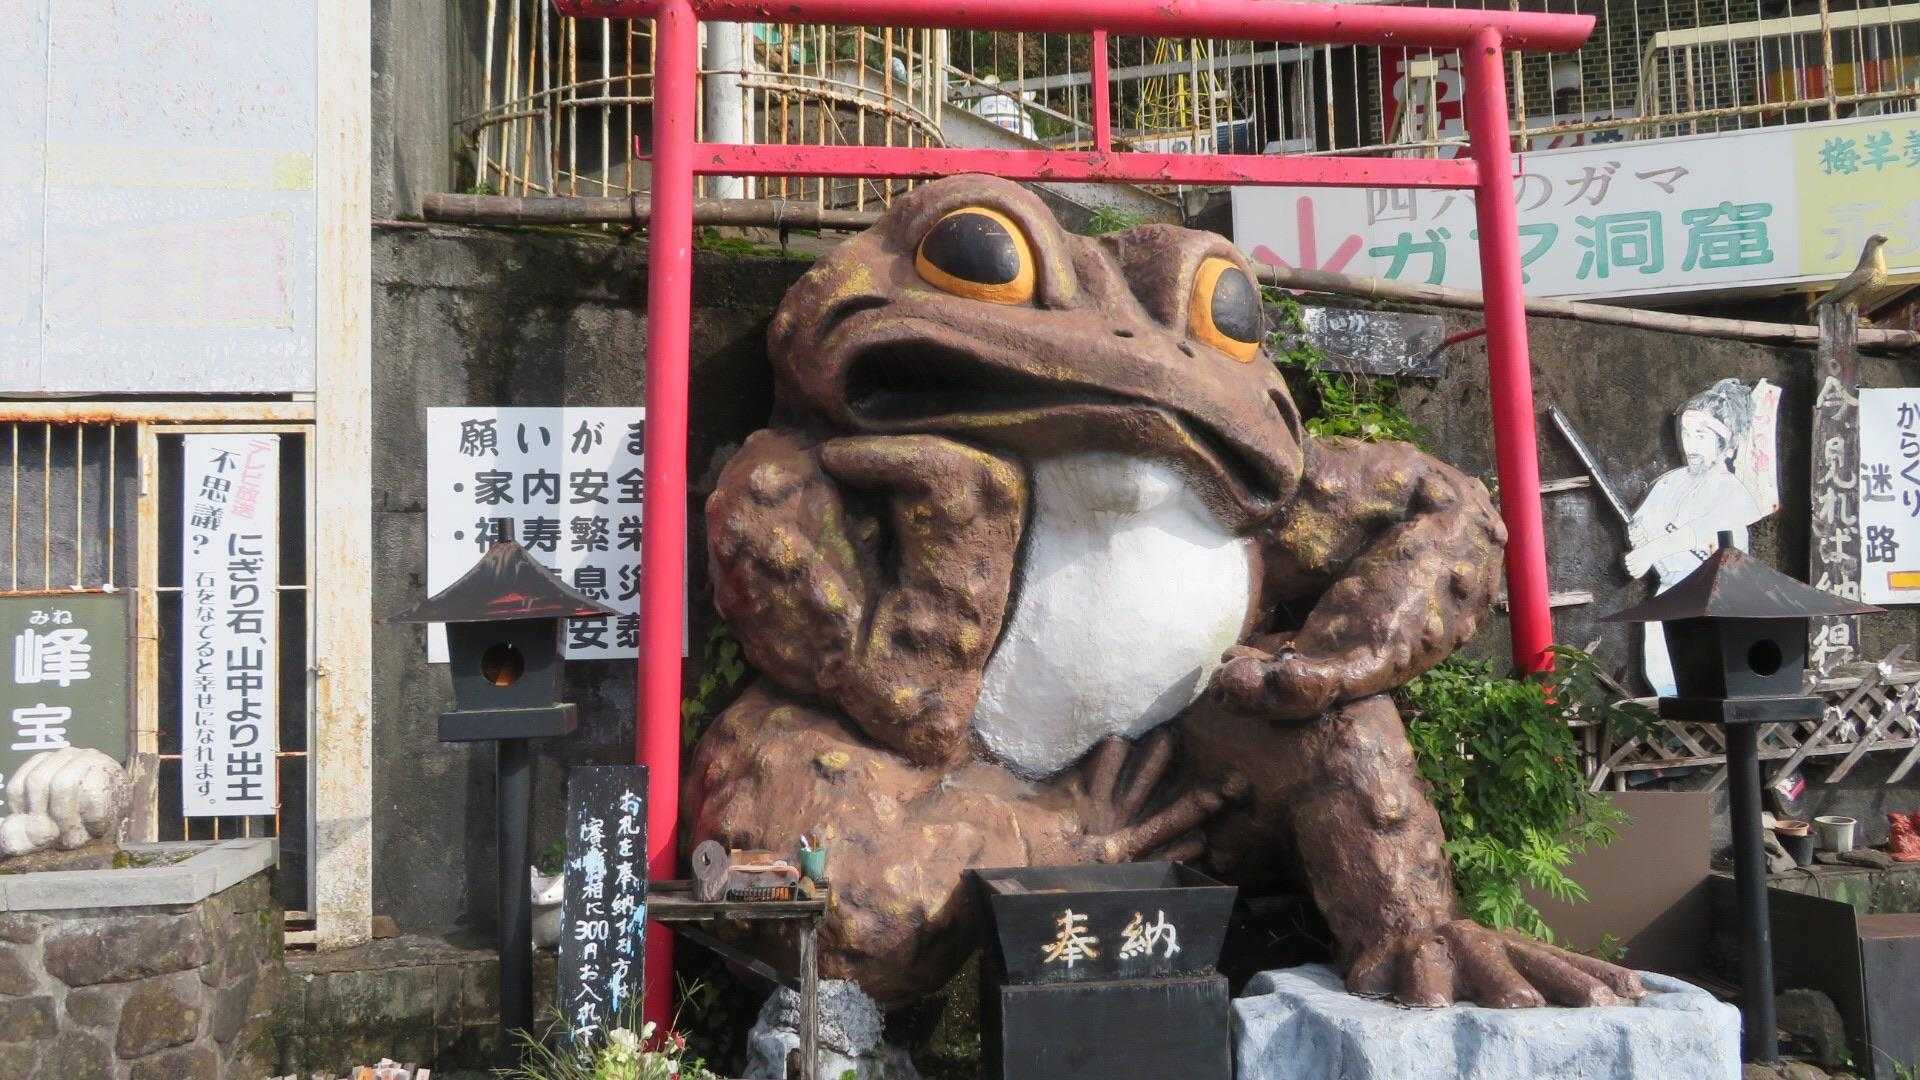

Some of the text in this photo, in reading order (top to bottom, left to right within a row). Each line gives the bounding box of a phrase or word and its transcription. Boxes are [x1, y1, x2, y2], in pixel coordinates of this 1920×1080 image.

[1860, 463, 1899, 563] 迷路
[29, 609, 73, 625] みね
[14, 628, 92, 688] 峰
[11, 703, 72, 751] 宝
[1041, 908, 1181, 968] 奉納
